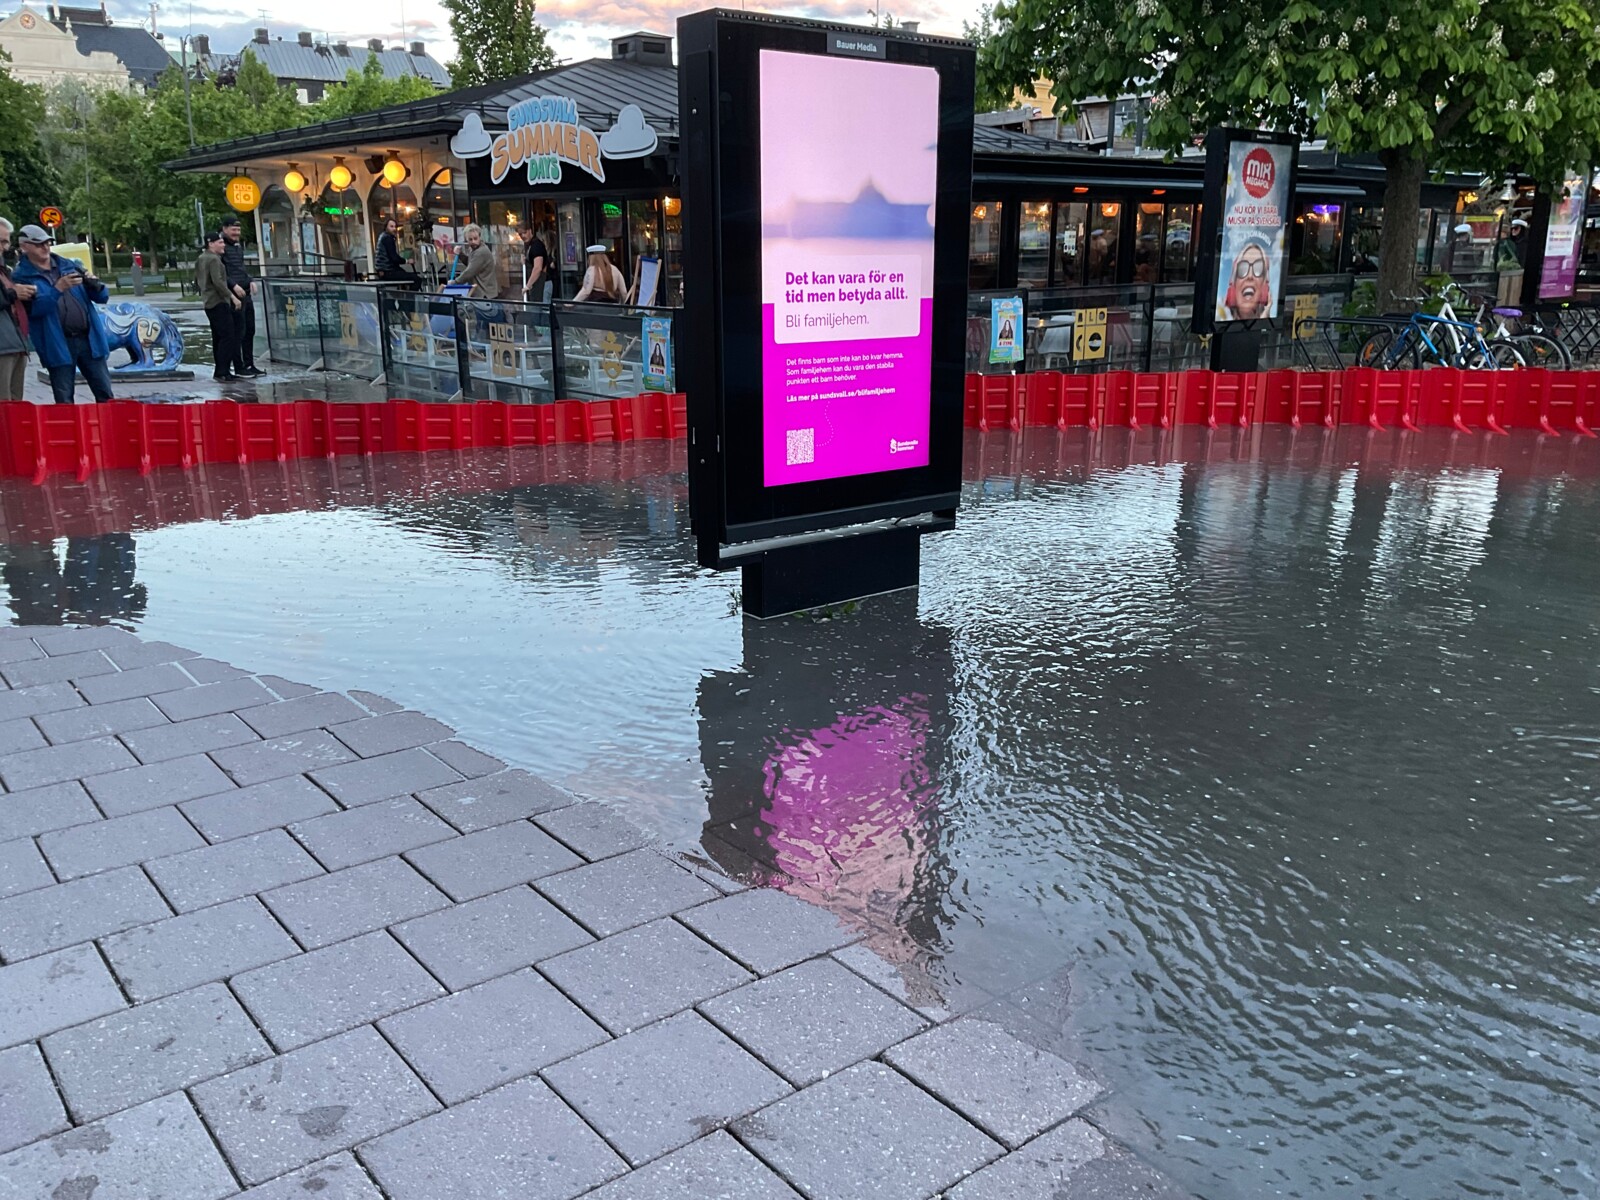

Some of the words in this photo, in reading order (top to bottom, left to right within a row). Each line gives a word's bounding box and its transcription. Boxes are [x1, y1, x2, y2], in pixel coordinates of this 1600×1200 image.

[836, 40, 856, 50] Bauer
[856, 42, 877, 52] Media
[509, 98, 576, 130] SUNDSVALL
[493, 123, 602, 181] SUMMER
[530, 157, 559, 181] DAYS
[1245, 176, 1270, 190] MEGAPOL
[1234, 205, 1243, 214] NU
[1244, 203, 1256, 214] KÖR
[1257, 206, 1262, 214] VI
[1263, 206, 1277, 215] BARA
[1227, 216, 1247, 225] MUSIK
[1248, 214, 1255, 225] PÅ
[1256, 216, 1280, 225] SVENSKA
[785, 271, 809, 285] Det
[812, 271, 835, 284] kan
[838, 273, 866, 284] vara
[868, 270, 886, 283] för
[889, 272, 904, 283] en
[785, 289, 803, 303] tid
[807, 291, 835, 303] men
[838, 287, 881, 305] betyda
[884, 287, 908, 300] allt.
[786, 314, 801, 328] Bli
[804, 313, 870, 329] familjehem.
[786, 358, 797, 366] Det
[798, 357, 812, 365] finns
[813, 356, 825, 364] barn
[827, 356, 839, 364] som
[851, 354, 861, 362] kan
[862, 353, 870, 361] bo
[786, 368, 800, 376] Som
[800, 366, 832, 375] familjehem
[833, 364, 843, 372] kan
[852, 363, 864, 371] vara
[865, 362, 876, 370] den
[877, 361, 894, 369] stabila
[786, 376, 810, 386] punkten
[811, 376, 819, 384] ett
[820, 375, 833, 383] barn
[786, 394, 797, 403] Läs
[811, 393, 818, 402] på
